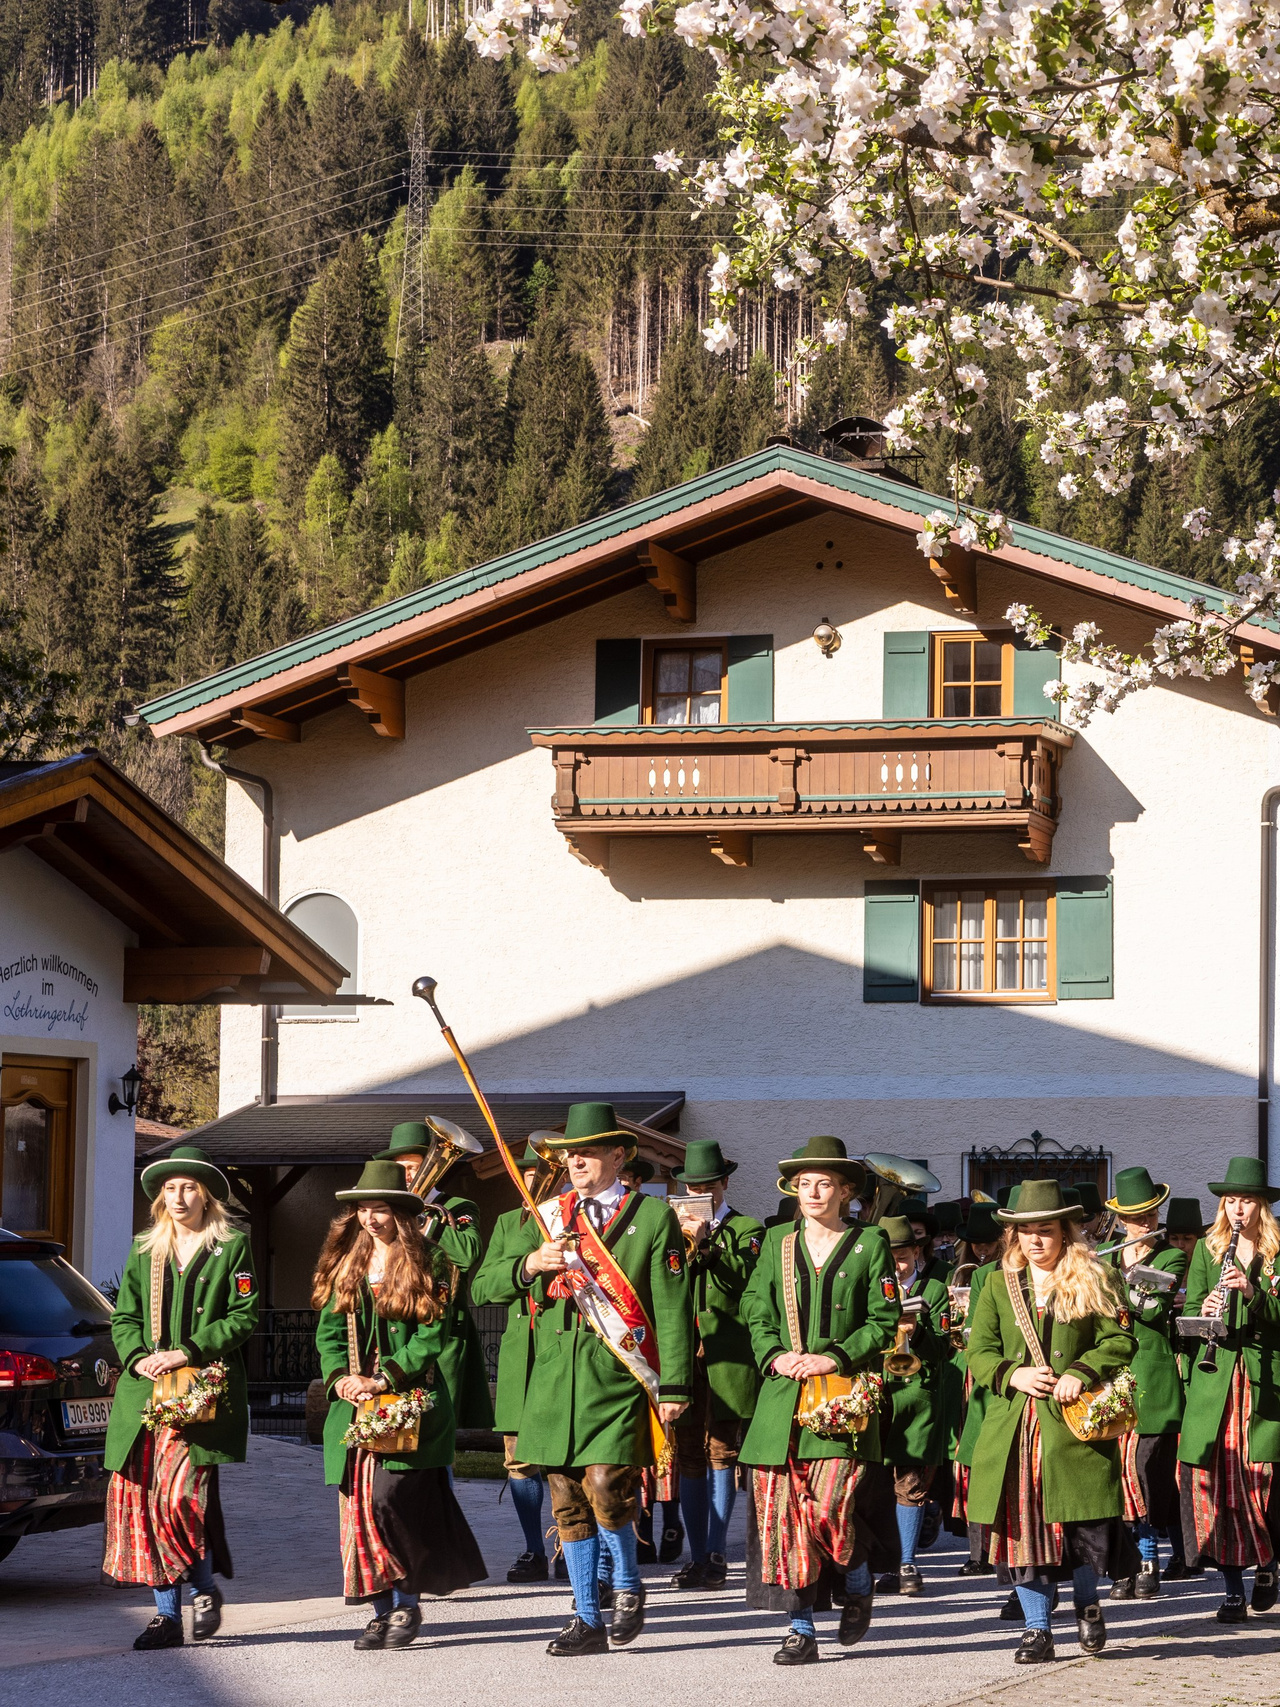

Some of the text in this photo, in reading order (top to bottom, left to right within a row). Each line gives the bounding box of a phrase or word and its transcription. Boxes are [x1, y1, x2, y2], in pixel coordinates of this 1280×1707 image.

[41, 954, 98, 997] willkommen
[41, 978, 53, 996] im
[4, 990, 88, 1031] Lothringerhof
[69, 1404, 83, 1424] JO
[88, 1402, 107, 1423] 996
